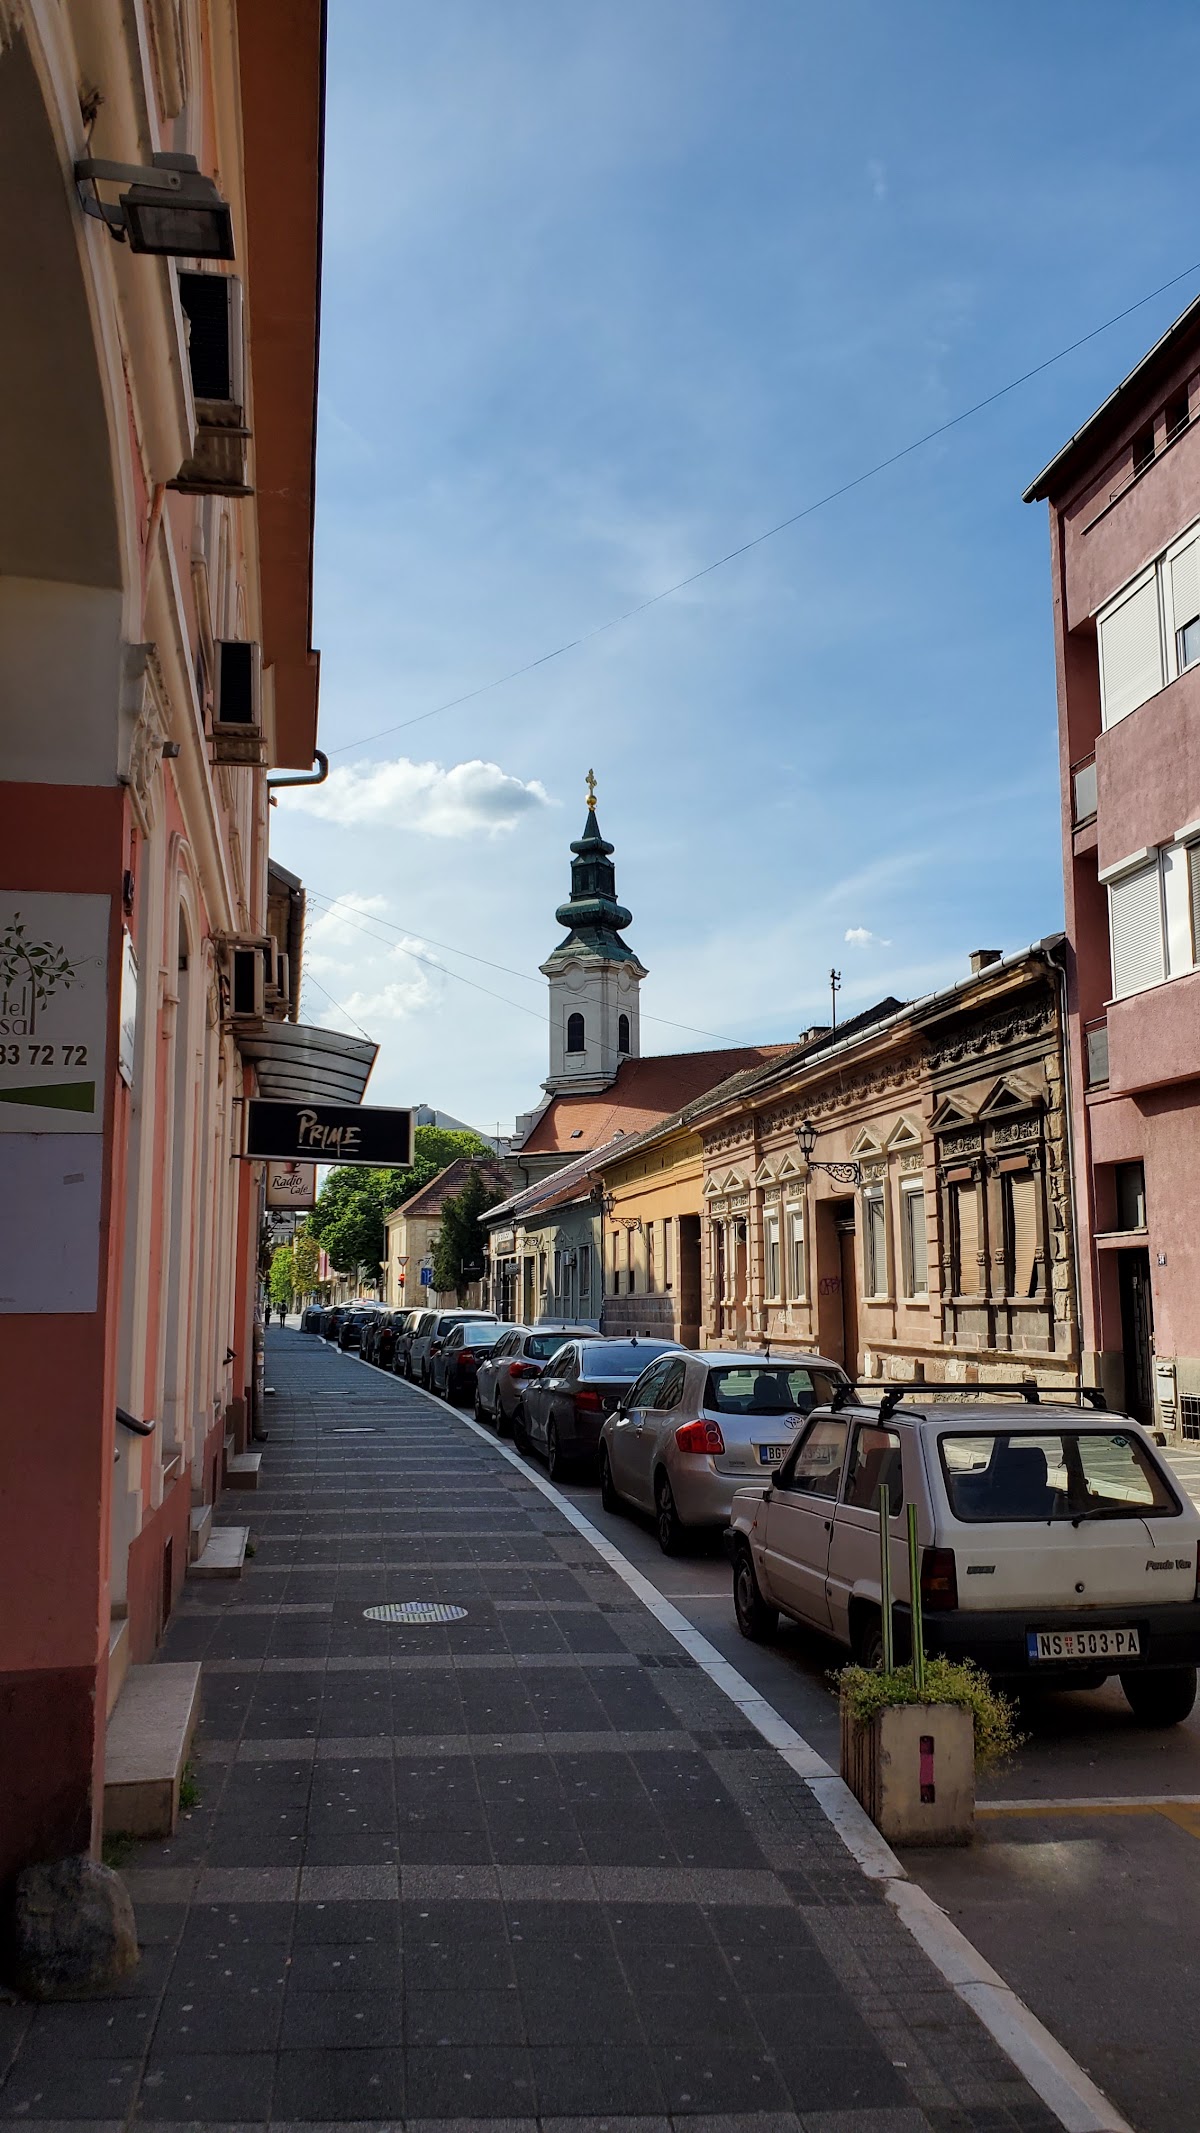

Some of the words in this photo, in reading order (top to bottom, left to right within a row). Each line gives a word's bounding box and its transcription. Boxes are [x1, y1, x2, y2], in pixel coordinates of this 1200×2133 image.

[28, 1045, 54, 1066] 72
[61, 1045, 88, 1066] 72
[297, 1109, 362, 1157] PRIME
[272, 1175, 303, 1190] Radio
[769, 1447, 781, 1460] BG
[1040, 1635, 1062, 1656] NS
